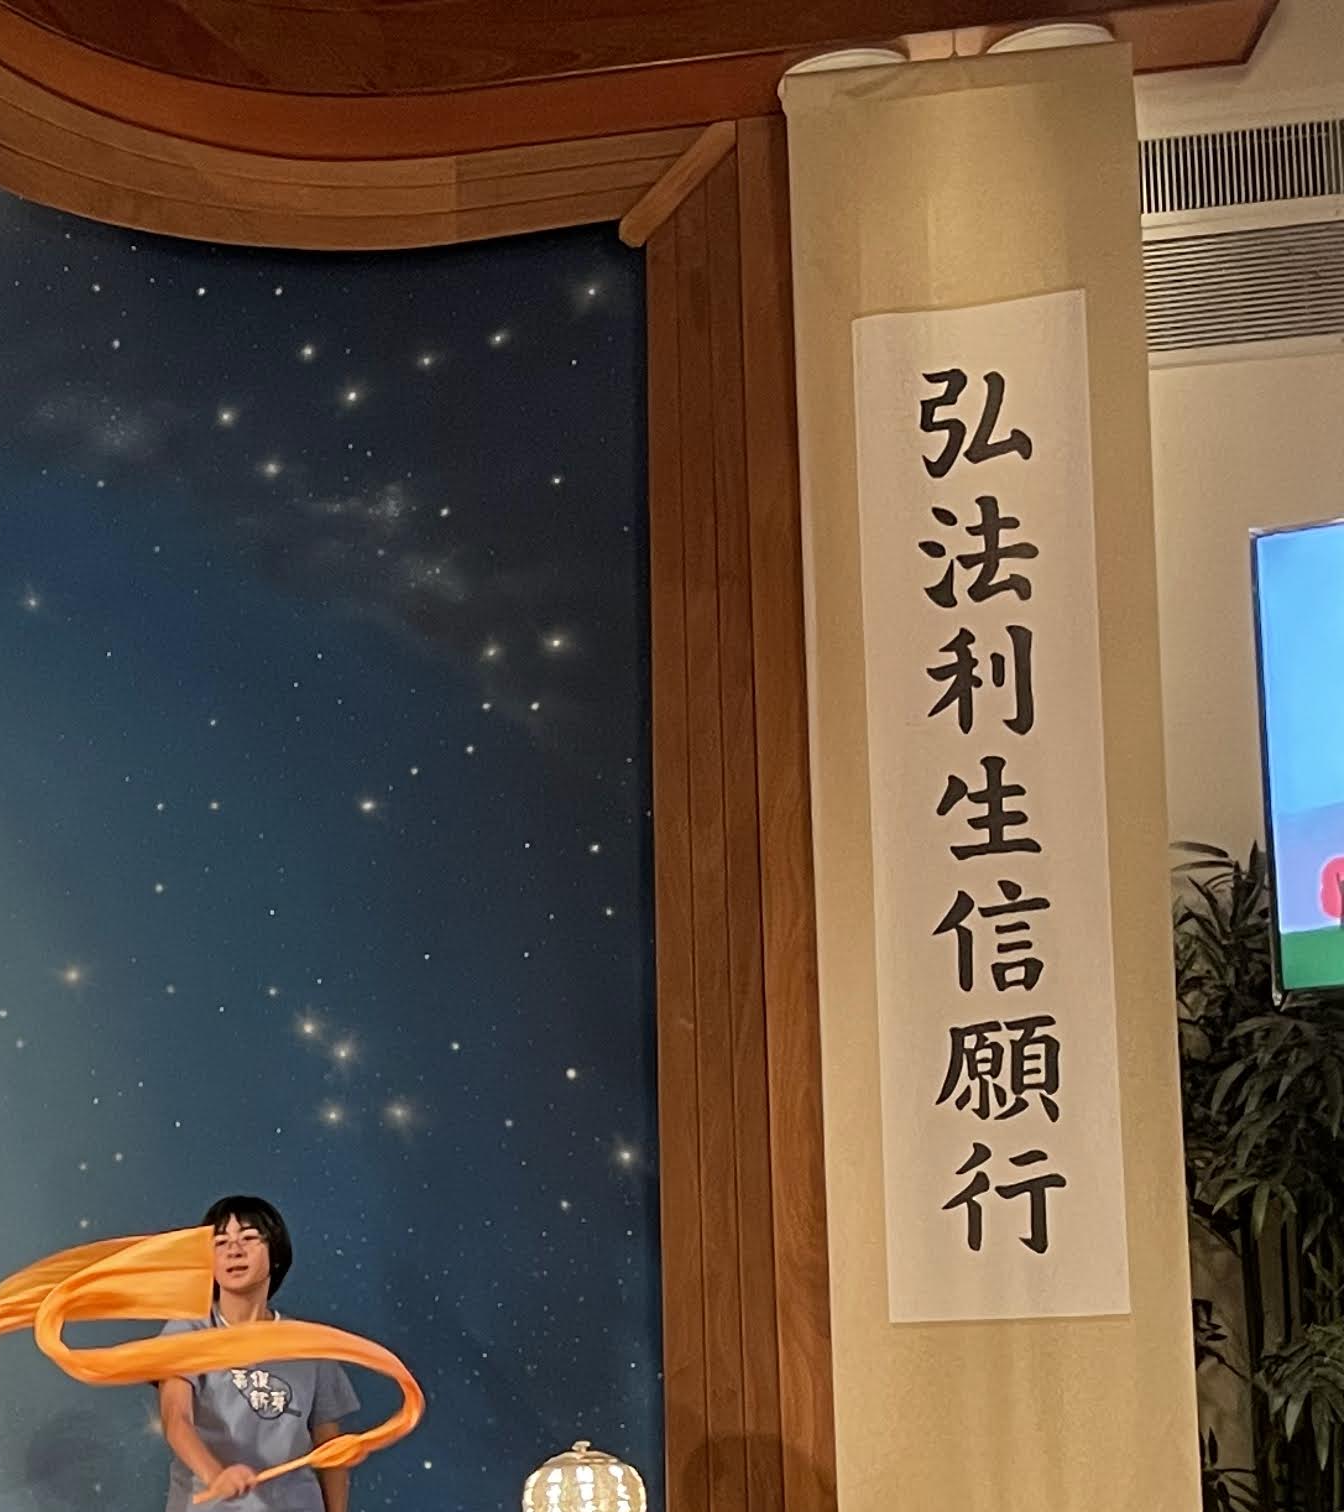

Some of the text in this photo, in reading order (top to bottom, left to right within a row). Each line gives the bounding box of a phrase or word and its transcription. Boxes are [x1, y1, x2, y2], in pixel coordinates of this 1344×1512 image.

[918, 367, 1067, 1254] 弘法利生信願行
